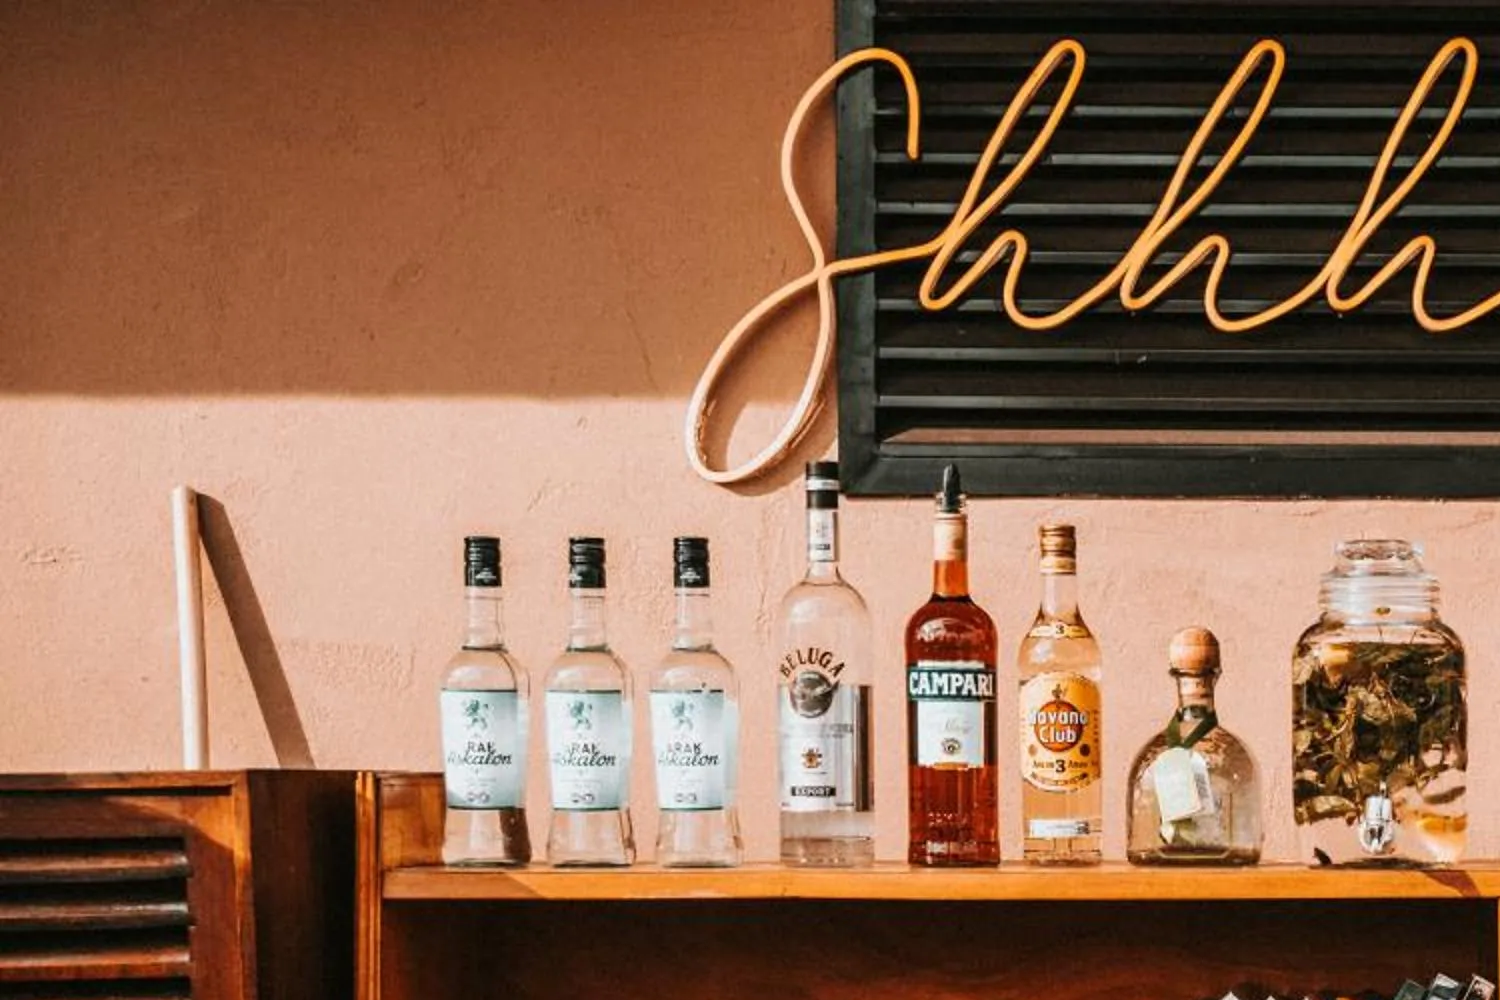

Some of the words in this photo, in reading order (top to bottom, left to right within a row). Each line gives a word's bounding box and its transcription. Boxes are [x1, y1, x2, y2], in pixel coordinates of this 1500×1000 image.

[779, 647, 845, 678] BELUGA
[909, 671, 995, 697] CAMPARI
[1039, 725, 1078, 743] Club
[1055, 759, 1066, 773] 3
